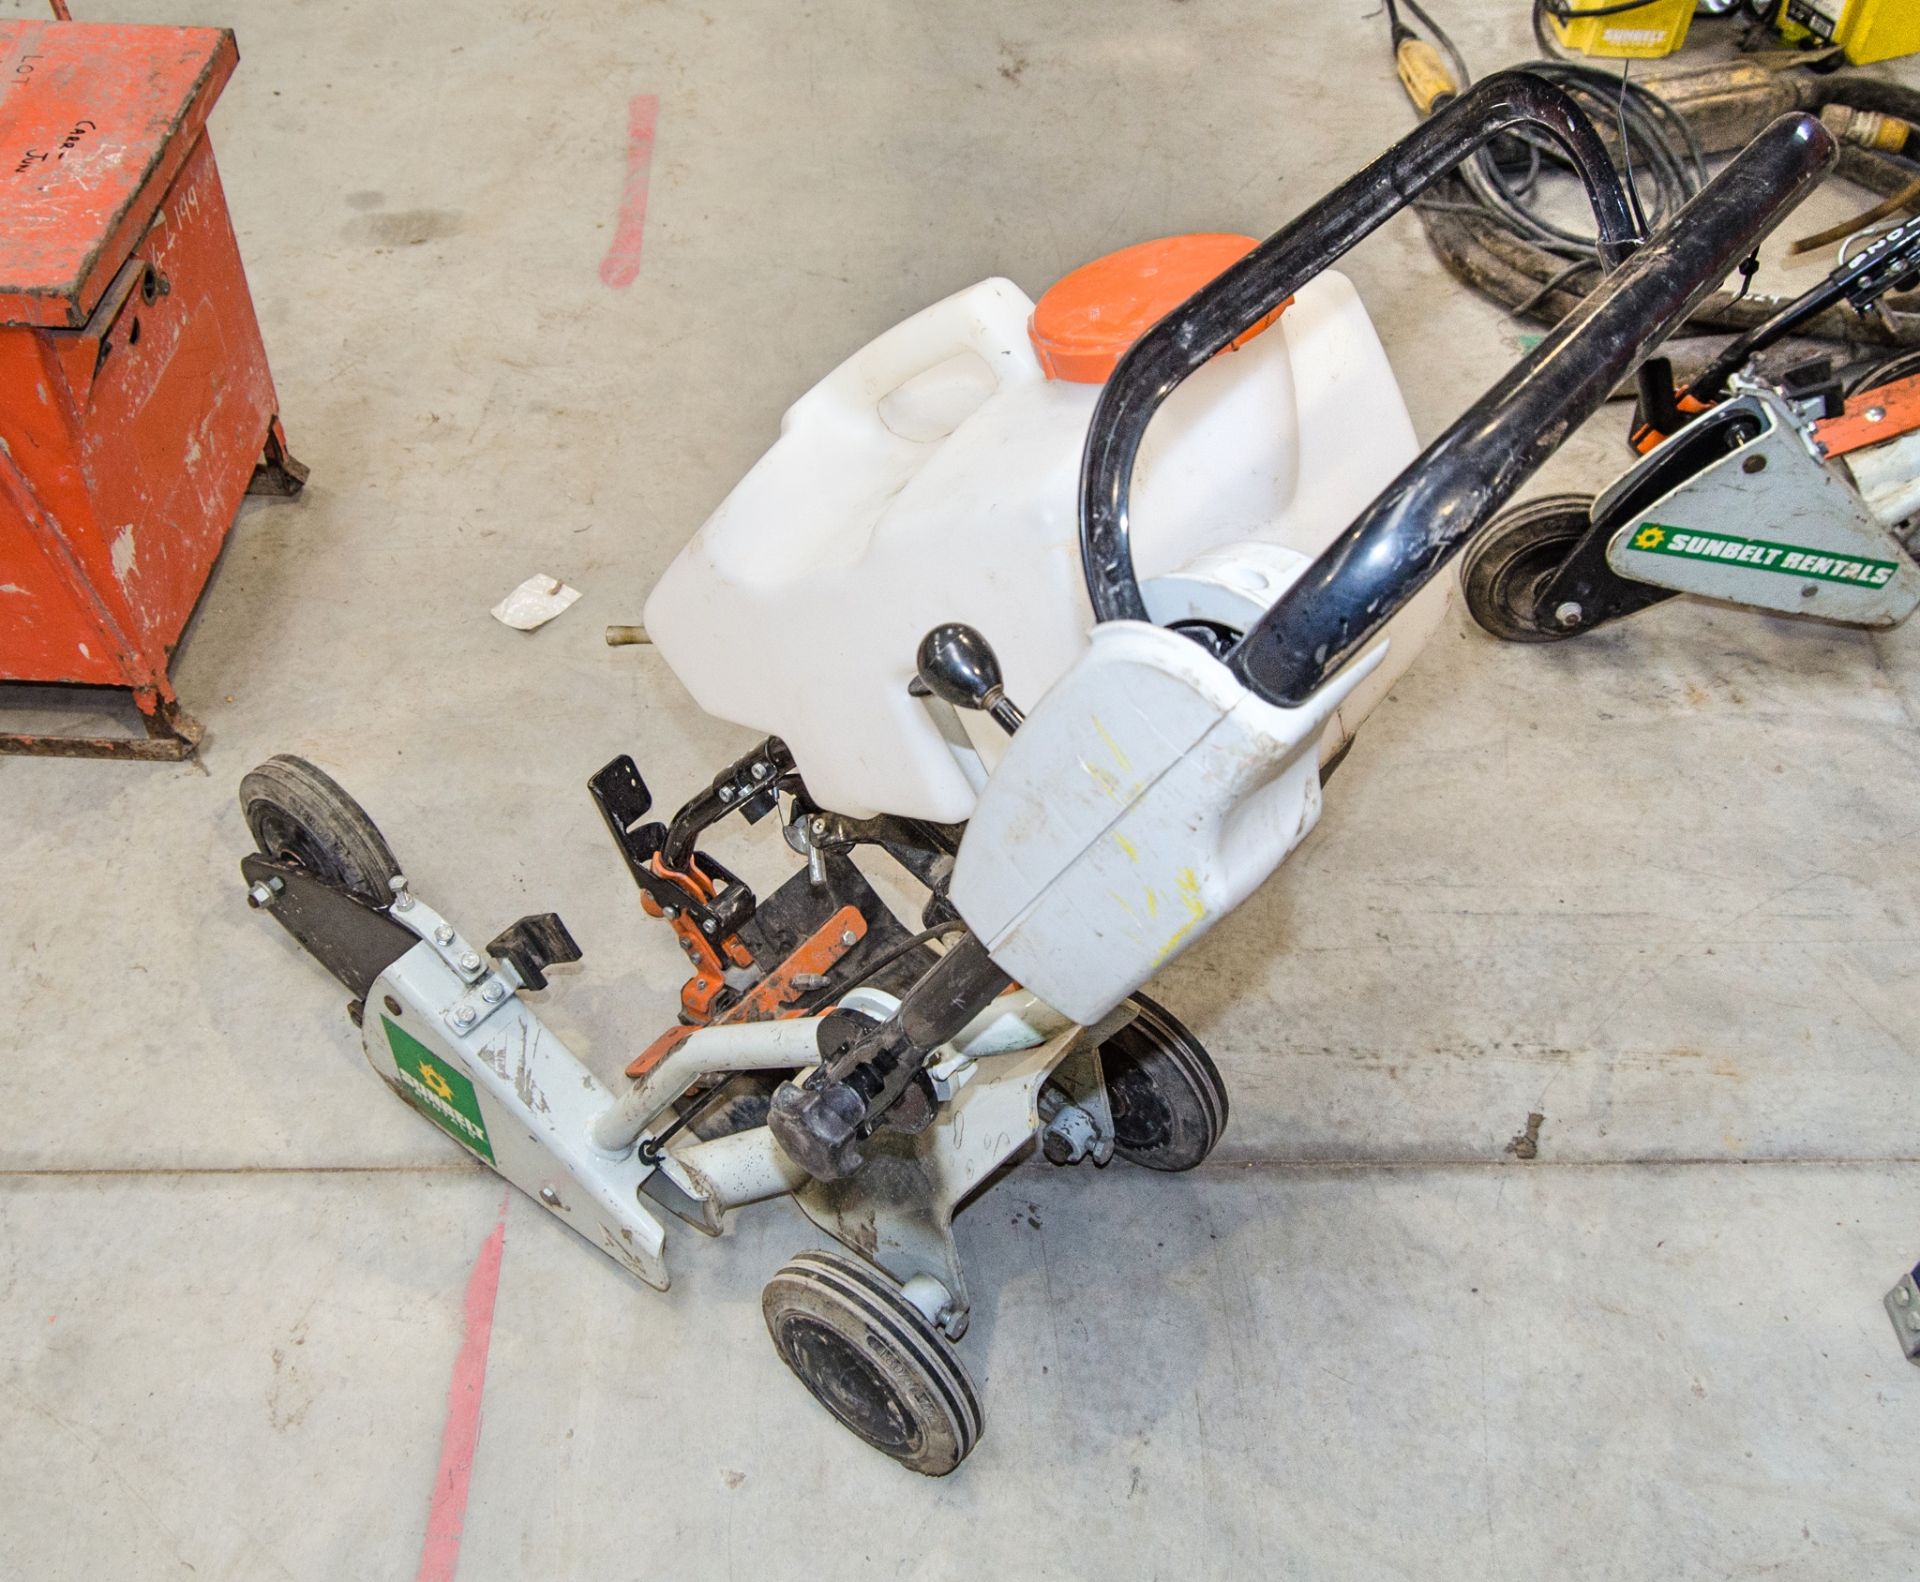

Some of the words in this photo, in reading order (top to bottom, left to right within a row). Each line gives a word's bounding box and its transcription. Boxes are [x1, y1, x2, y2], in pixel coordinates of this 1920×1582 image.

[11, 55, 44, 86] LOT
[1667, 533, 1783, 566] SUNBELT
[1780, 551, 1894, 585] RENTALS
